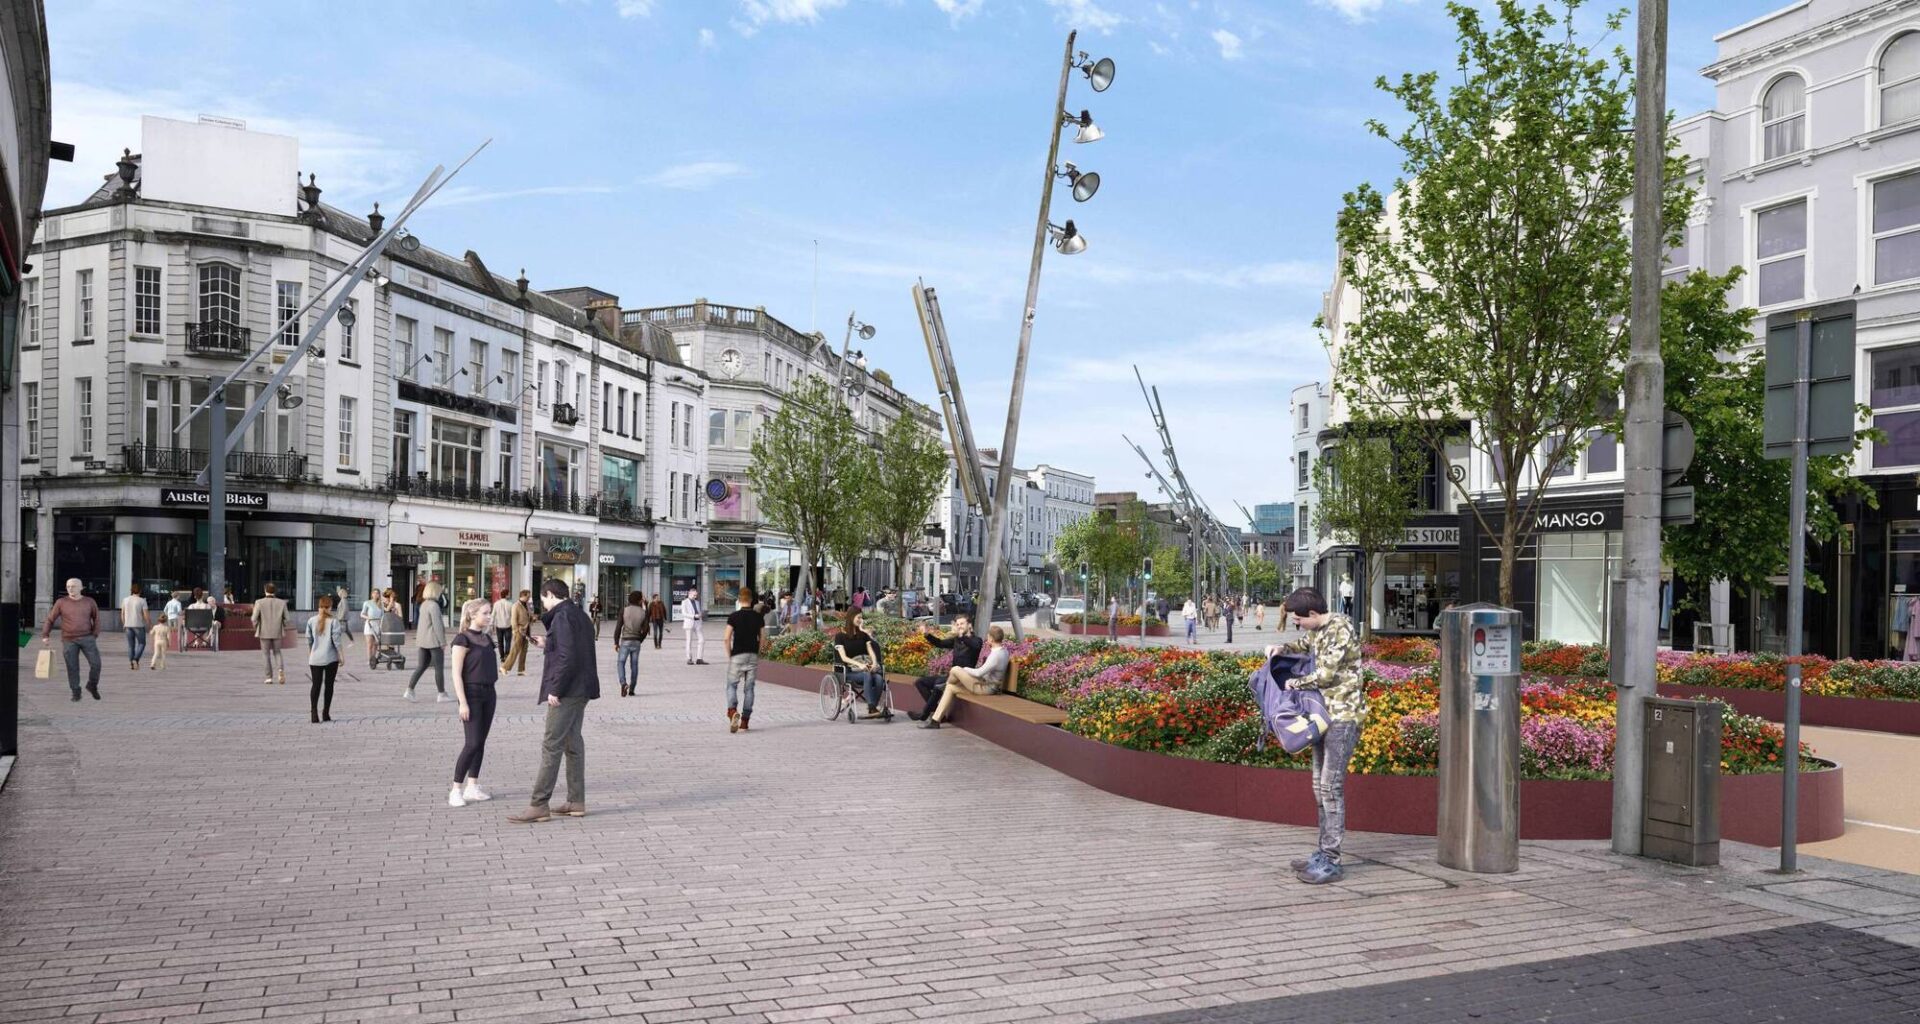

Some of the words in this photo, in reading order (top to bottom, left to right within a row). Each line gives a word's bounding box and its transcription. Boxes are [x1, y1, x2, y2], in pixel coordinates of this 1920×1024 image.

[226, 493, 263, 505] Blake
[1534, 511, 1604, 529] MANGO
[1656, 711, 1661, 719] 2
